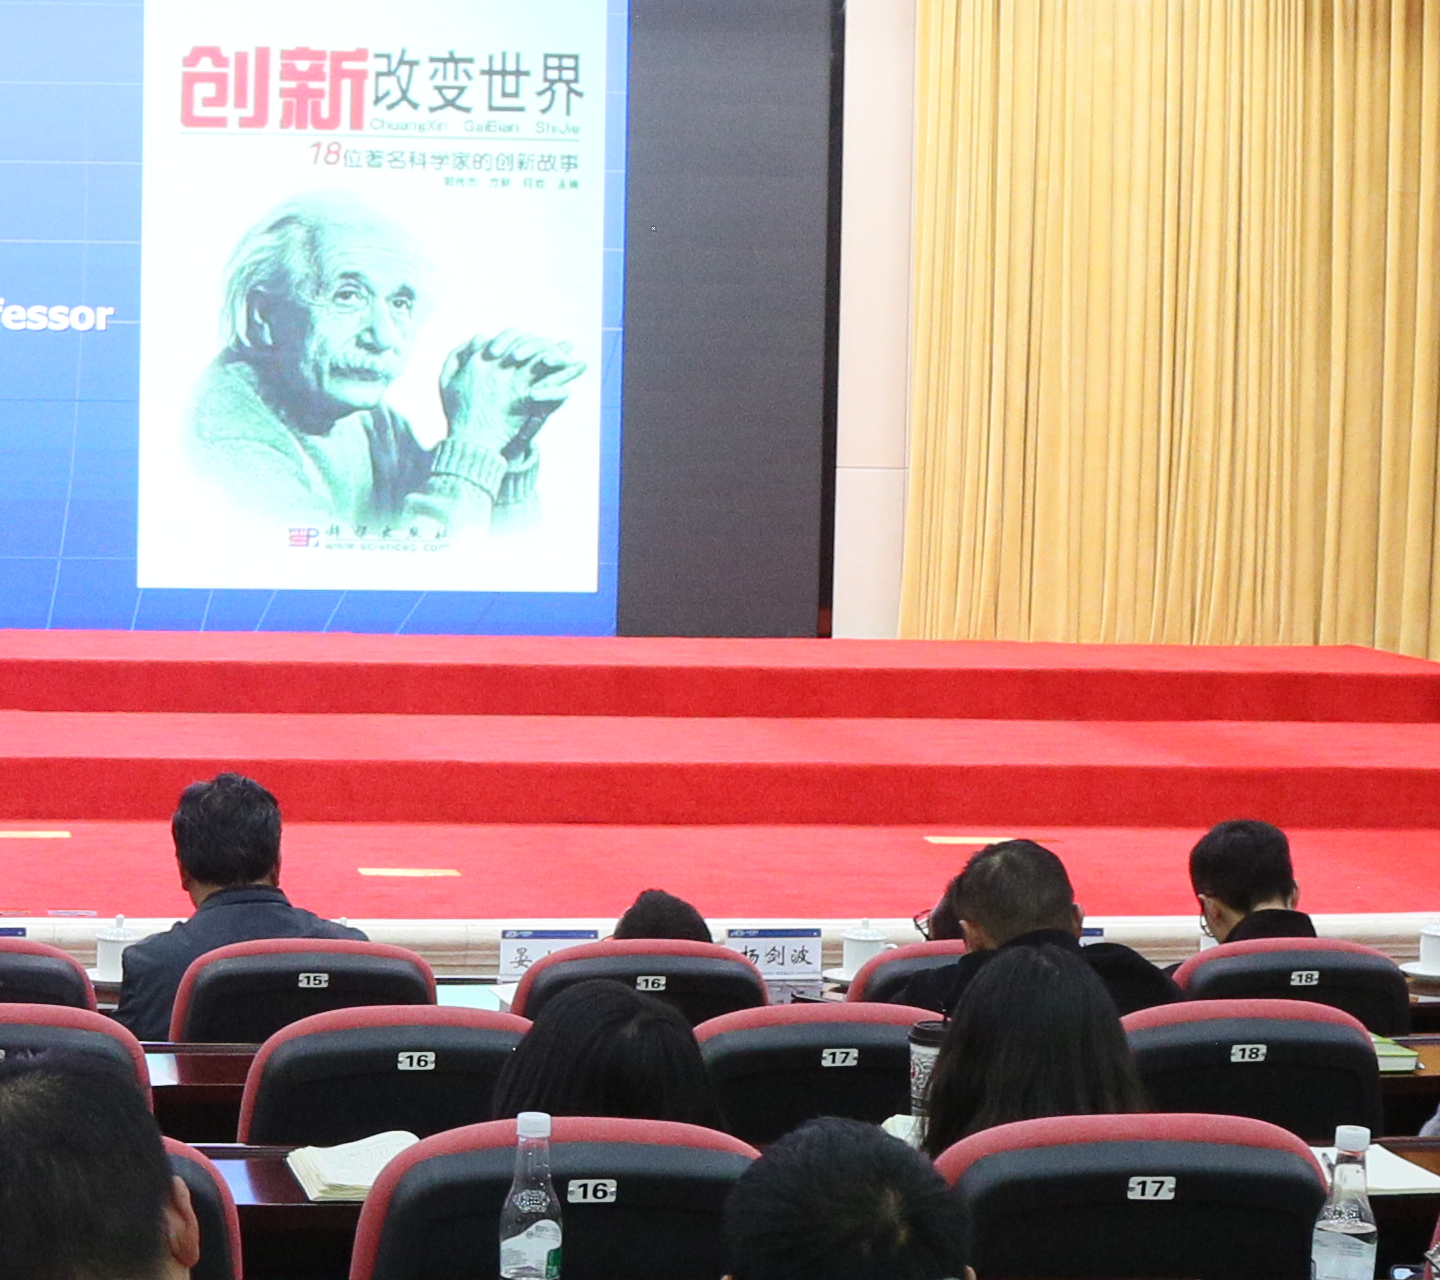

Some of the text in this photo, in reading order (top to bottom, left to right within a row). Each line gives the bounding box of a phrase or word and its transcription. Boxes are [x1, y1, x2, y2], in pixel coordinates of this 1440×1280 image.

[306, 975, 322, 986] 15
[643, 978, 660, 989] 16
[1296, 973, 1313, 984] 18
[828, 1051, 849, 1064] 17
[1238, 1046, 1259, 1059] 18
[406, 1054, 428, 1068] 16
[577, 1181, 607, 1199] 16
[1136, 1179, 1165, 1196] 17
